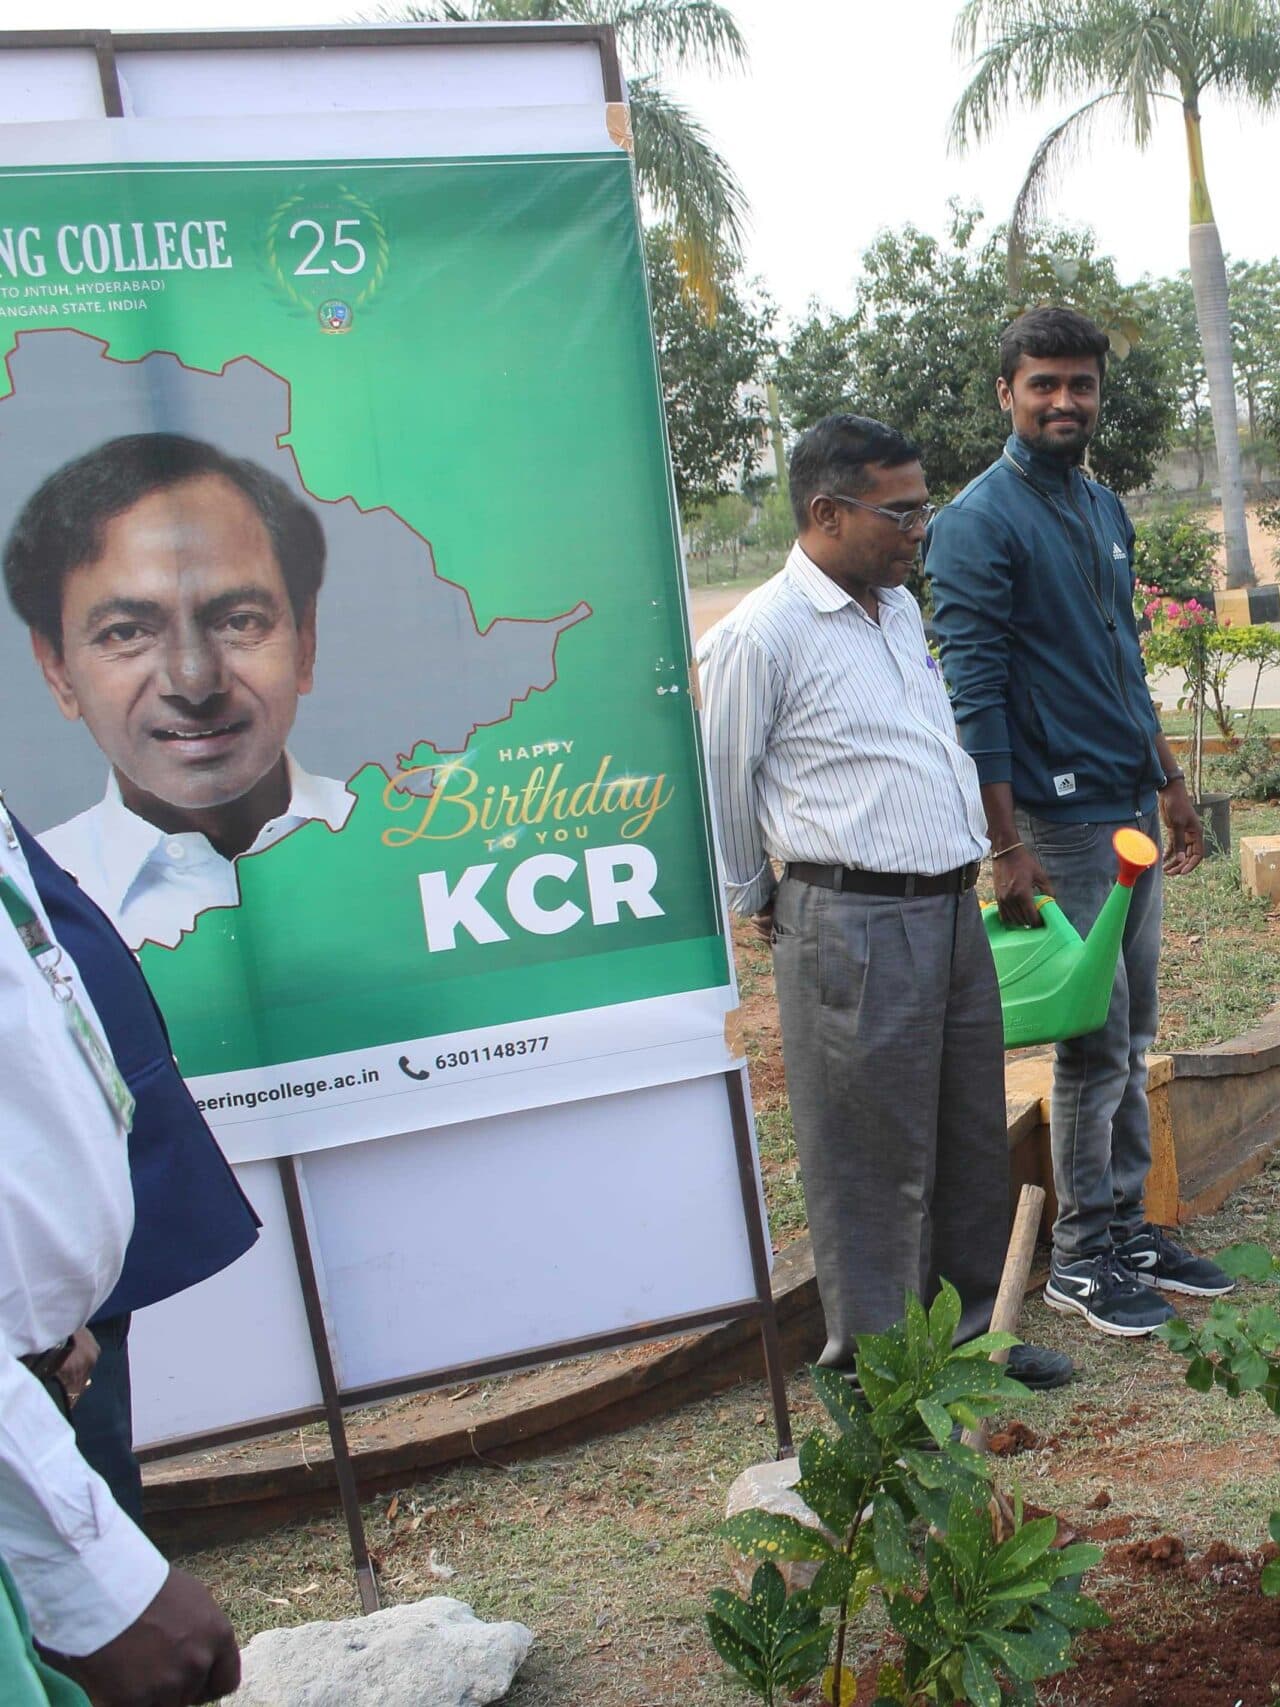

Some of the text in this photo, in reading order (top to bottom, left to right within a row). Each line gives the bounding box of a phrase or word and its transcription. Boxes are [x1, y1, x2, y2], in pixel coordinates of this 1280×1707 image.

[57, 221, 233, 275] COLLEGE
[289, 219, 366, 275] 25
[0, 287, 20, 298] TO
[76, 280, 165, 295] HYDERABAD)
[108, 300, 147, 312] INDIA
[498, 740, 575, 762] HAPPY
[381, 755, 675, 848] Birthday
[483, 825, 588, 851] TO YOU
[418, 843, 666, 953] KCR
[196, 1036, 549, 1112] eeringcollege.ac.in 6301148377
